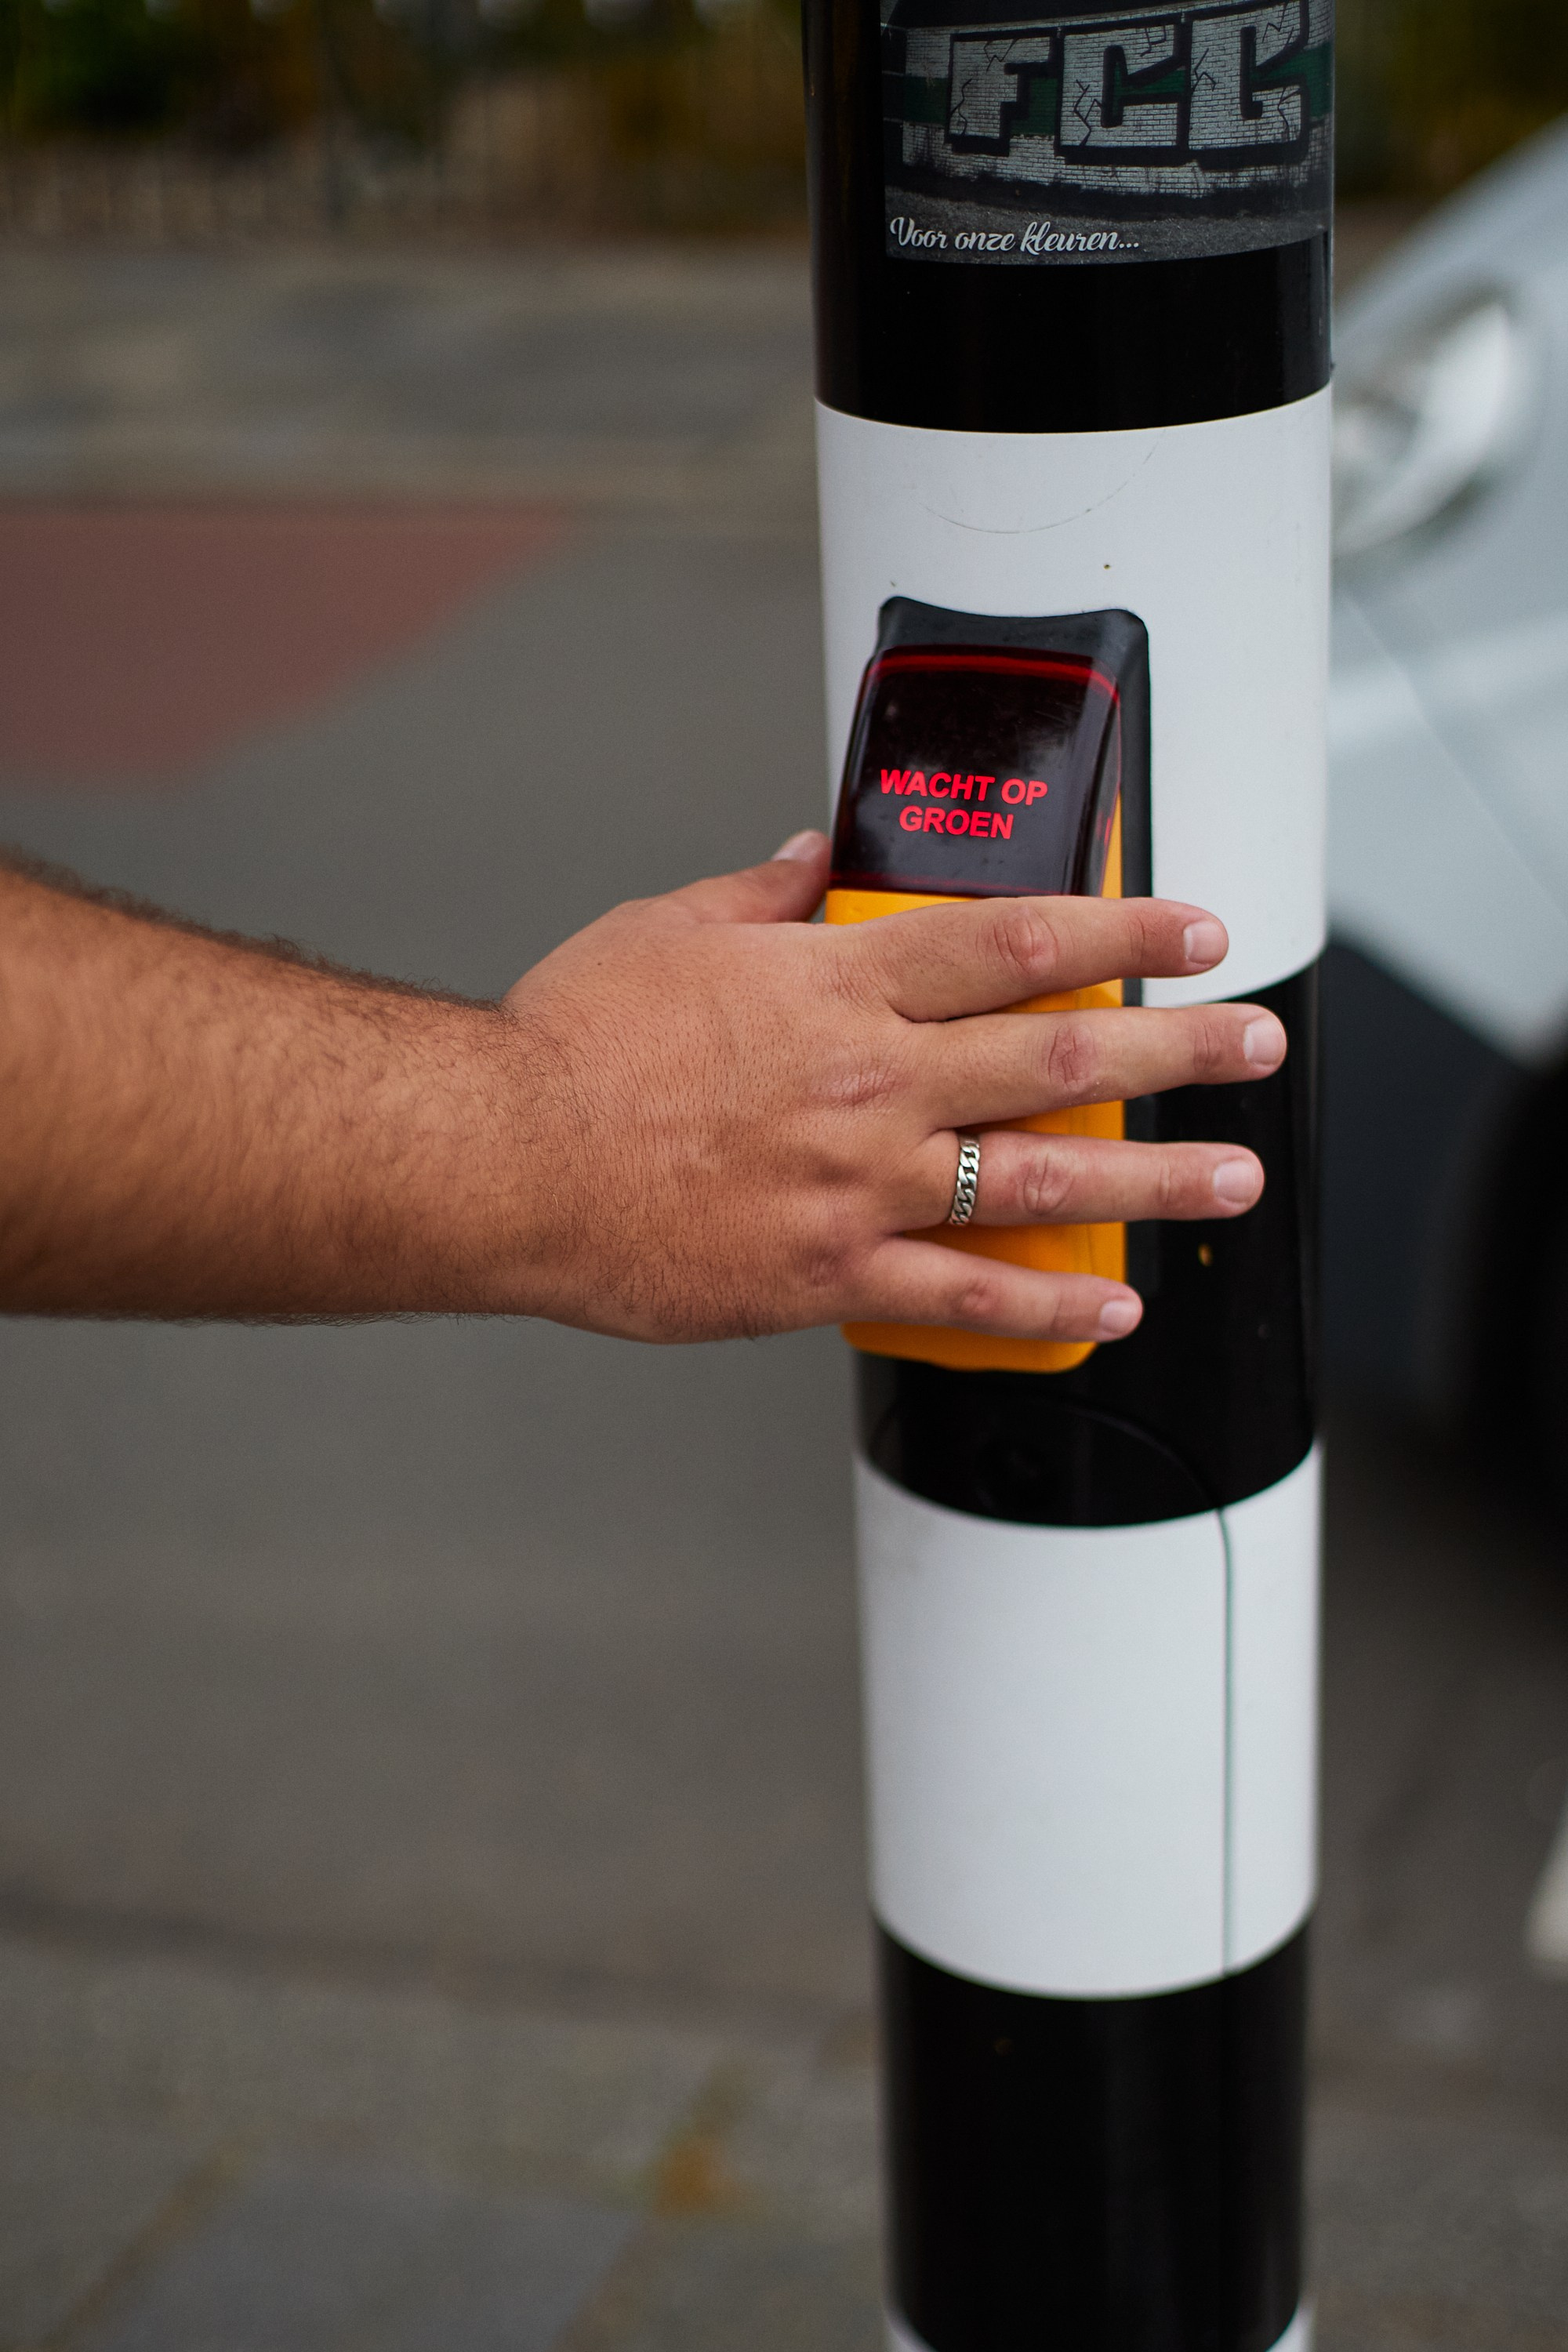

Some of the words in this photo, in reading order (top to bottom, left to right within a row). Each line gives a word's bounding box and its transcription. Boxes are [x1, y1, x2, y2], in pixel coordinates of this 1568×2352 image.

[890, 216, 947, 249] Voor
[955, 231, 1016, 251] onze
[1020, 221, 1139, 255] kleuren...
[880, 769, 996, 801] WACHT
[1001, 779, 1048, 806] OP
[899, 805, 1014, 840] GROEN
